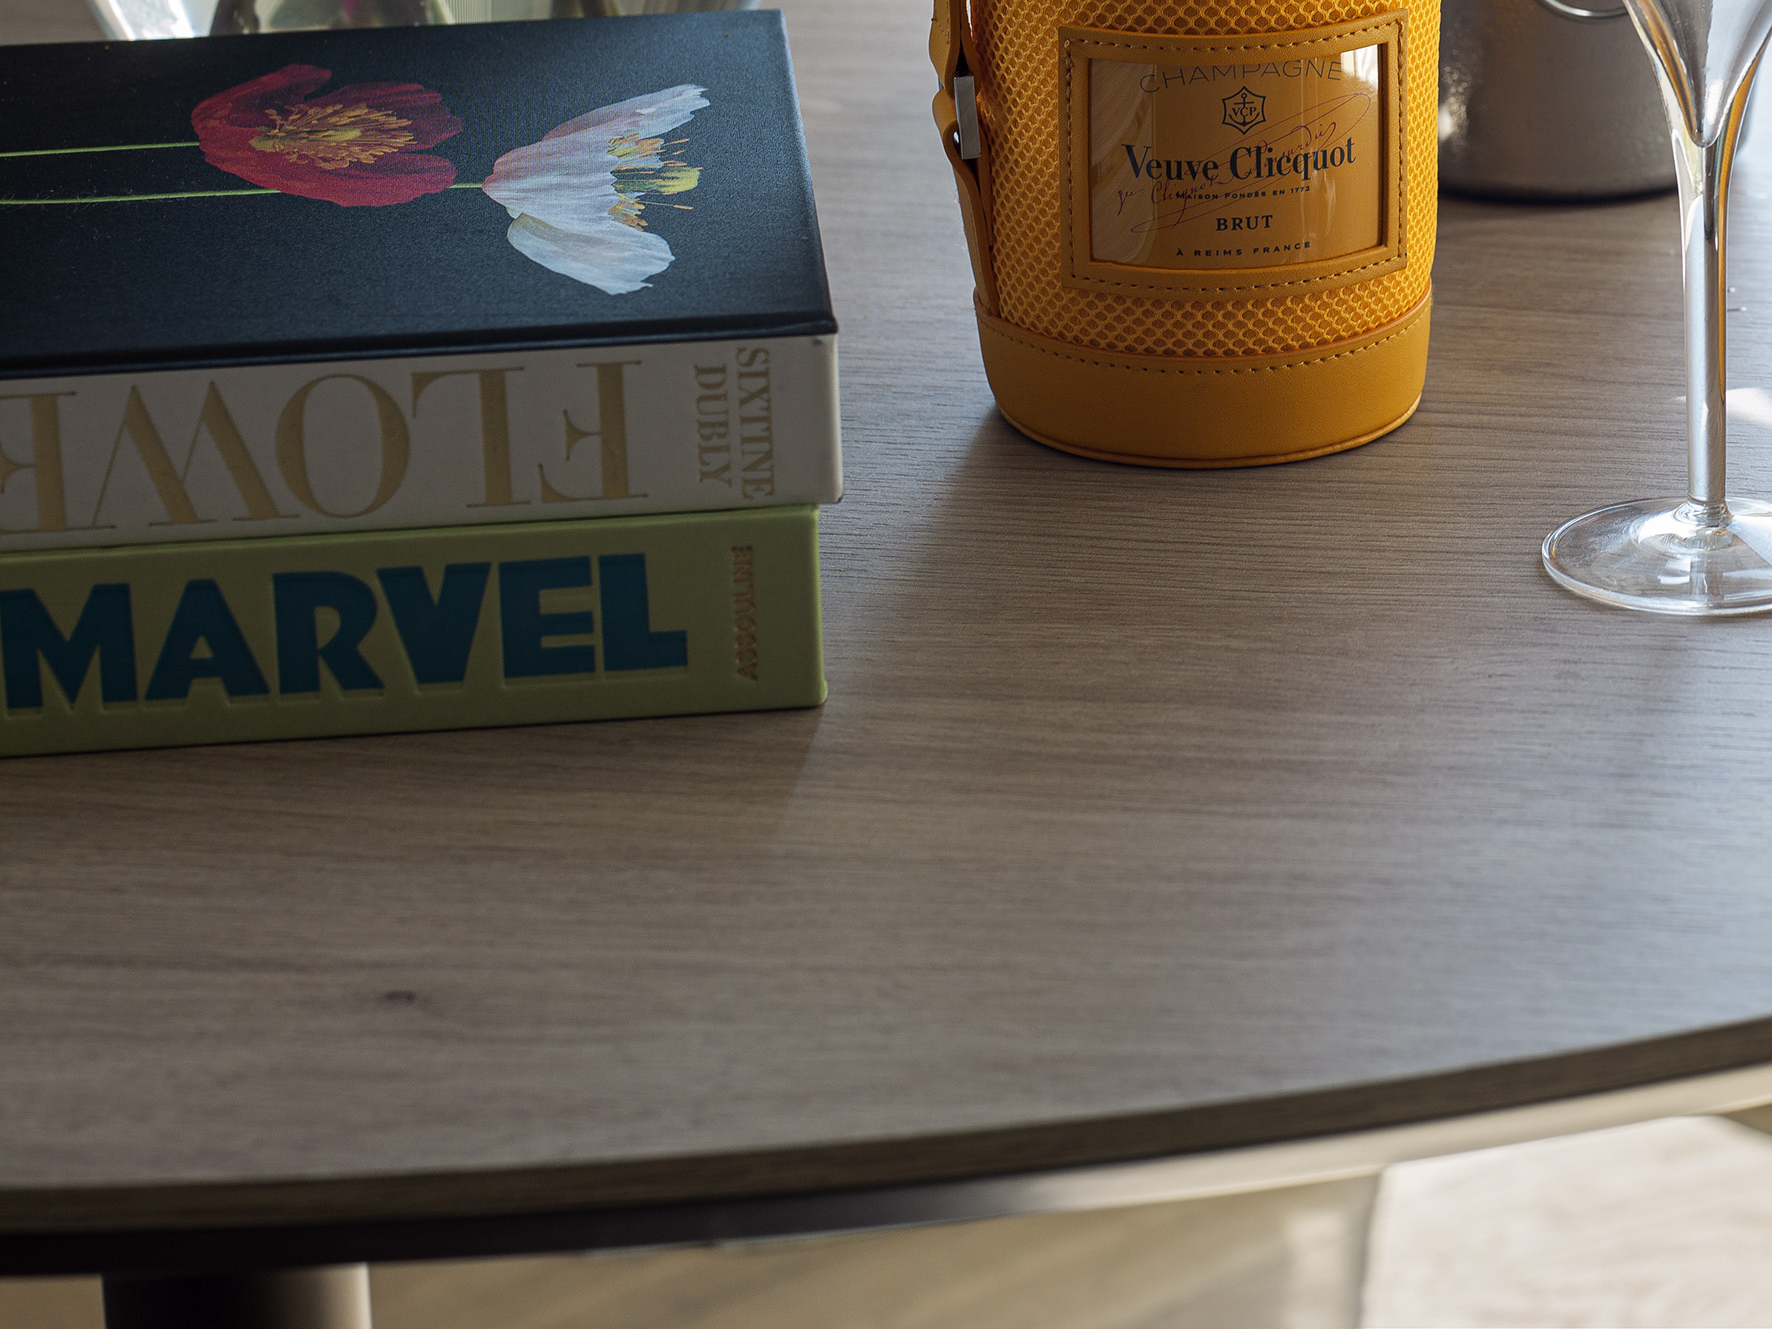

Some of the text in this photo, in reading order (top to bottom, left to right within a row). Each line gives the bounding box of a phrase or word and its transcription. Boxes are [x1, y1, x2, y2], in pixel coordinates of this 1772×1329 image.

[1140, 59, 1343, 93] CHAMPAGNE
[1232, 106, 1257, 117] VCP
[1121, 137, 1356, 181] Veuve Clicquot
[1216, 215, 1273, 231] BRUT
[1194, 249, 1243, 257] REIMS
[1253, 241, 1310, 254] FRANCE
[694, 363, 732, 488] DUBLY
[735, 347, 775, 500] SIXTINE
[0, 553, 688, 710] MARVEL
[731, 545, 759, 682] ASSOULINE
